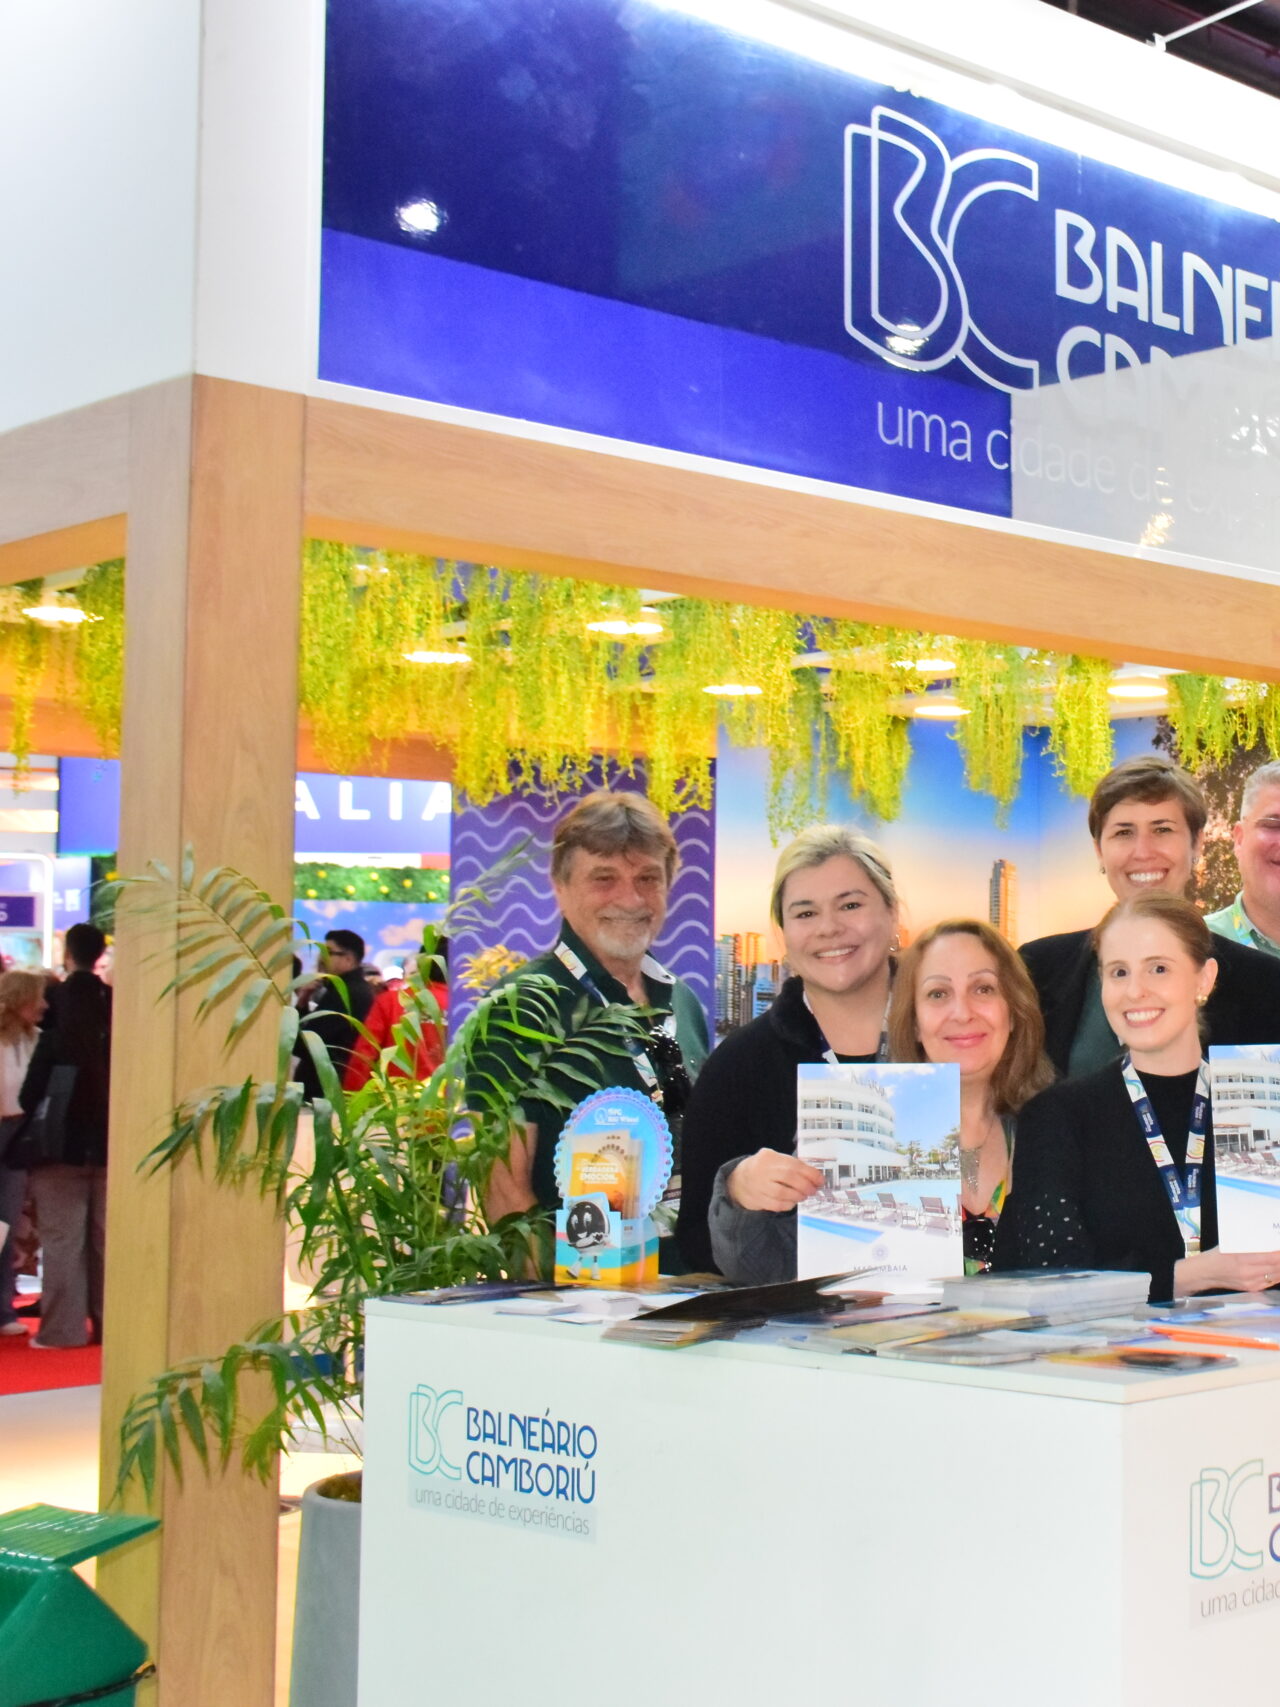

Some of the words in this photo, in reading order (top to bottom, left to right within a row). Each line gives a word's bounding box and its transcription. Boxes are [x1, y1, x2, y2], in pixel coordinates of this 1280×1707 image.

[876, 401, 972, 462] uma
[986, 418, 1116, 495] cidade
[466, 1407, 598, 1460] BALNEÁRIO
[466, 1451, 596, 1504] CAMBORIÚ
[415, 1488, 442, 1507] uma
[444, 1488, 486, 1515] cidade
[488, 1497, 505, 1519] de
[508, 1505, 590, 1536] experiências
[1200, 1592, 1237, 1618] uma
